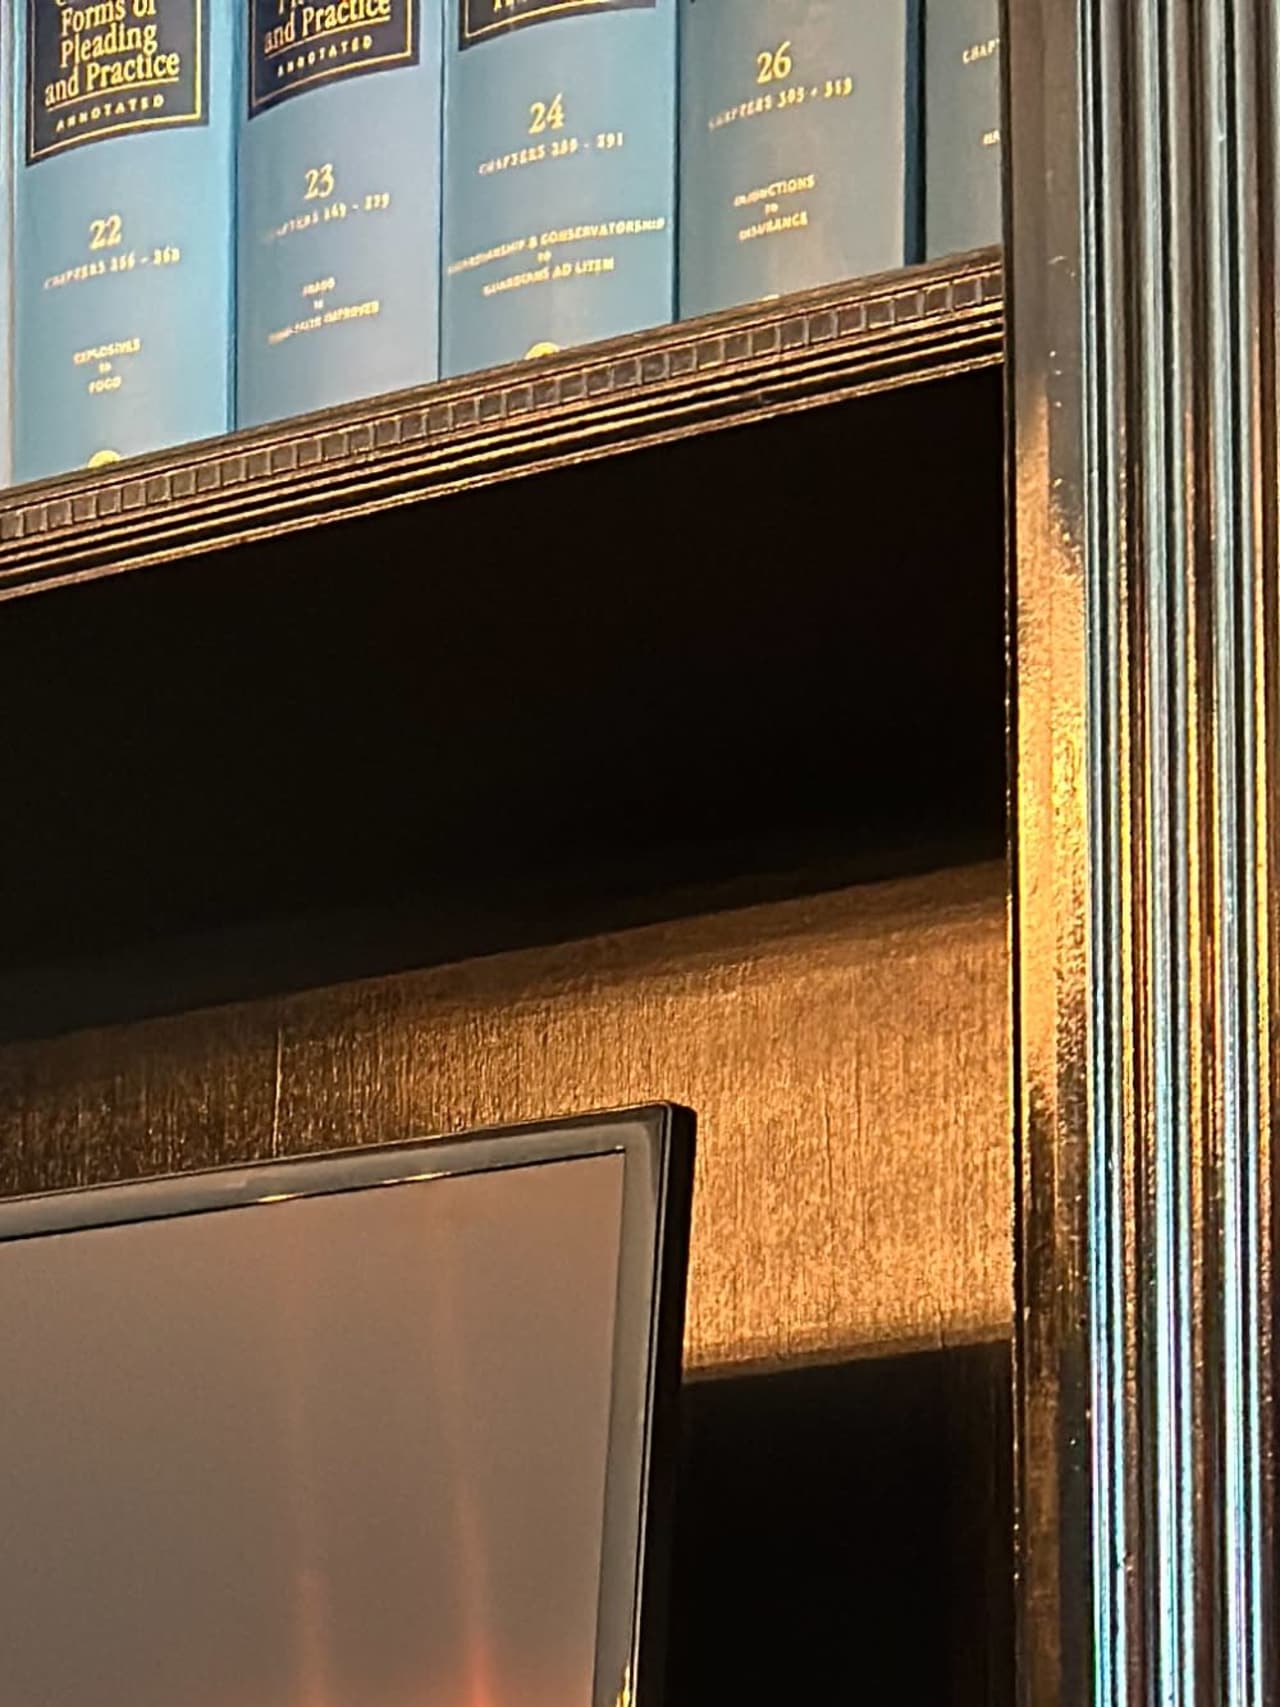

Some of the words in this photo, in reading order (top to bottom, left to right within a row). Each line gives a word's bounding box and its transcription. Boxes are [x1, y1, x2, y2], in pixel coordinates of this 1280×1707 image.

[61, 0, 125, 37] Forms
[264, 22, 296, 53] and
[302, 0, 390, 40] Practice
[60, 23, 157, 68] Pleading
[278, 35, 372, 77] ANNOTATED
[757, 41, 791, 84] 26
[45, 77, 79, 105] and
[86, 53, 180, 92] Practice
[56, 94, 164, 132] ANNOTATED
[529, 93, 564, 134] 24
[304, 164, 334, 200] 23
[90, 214, 121, 250] 22
[553, 262, 571, 279] AD
